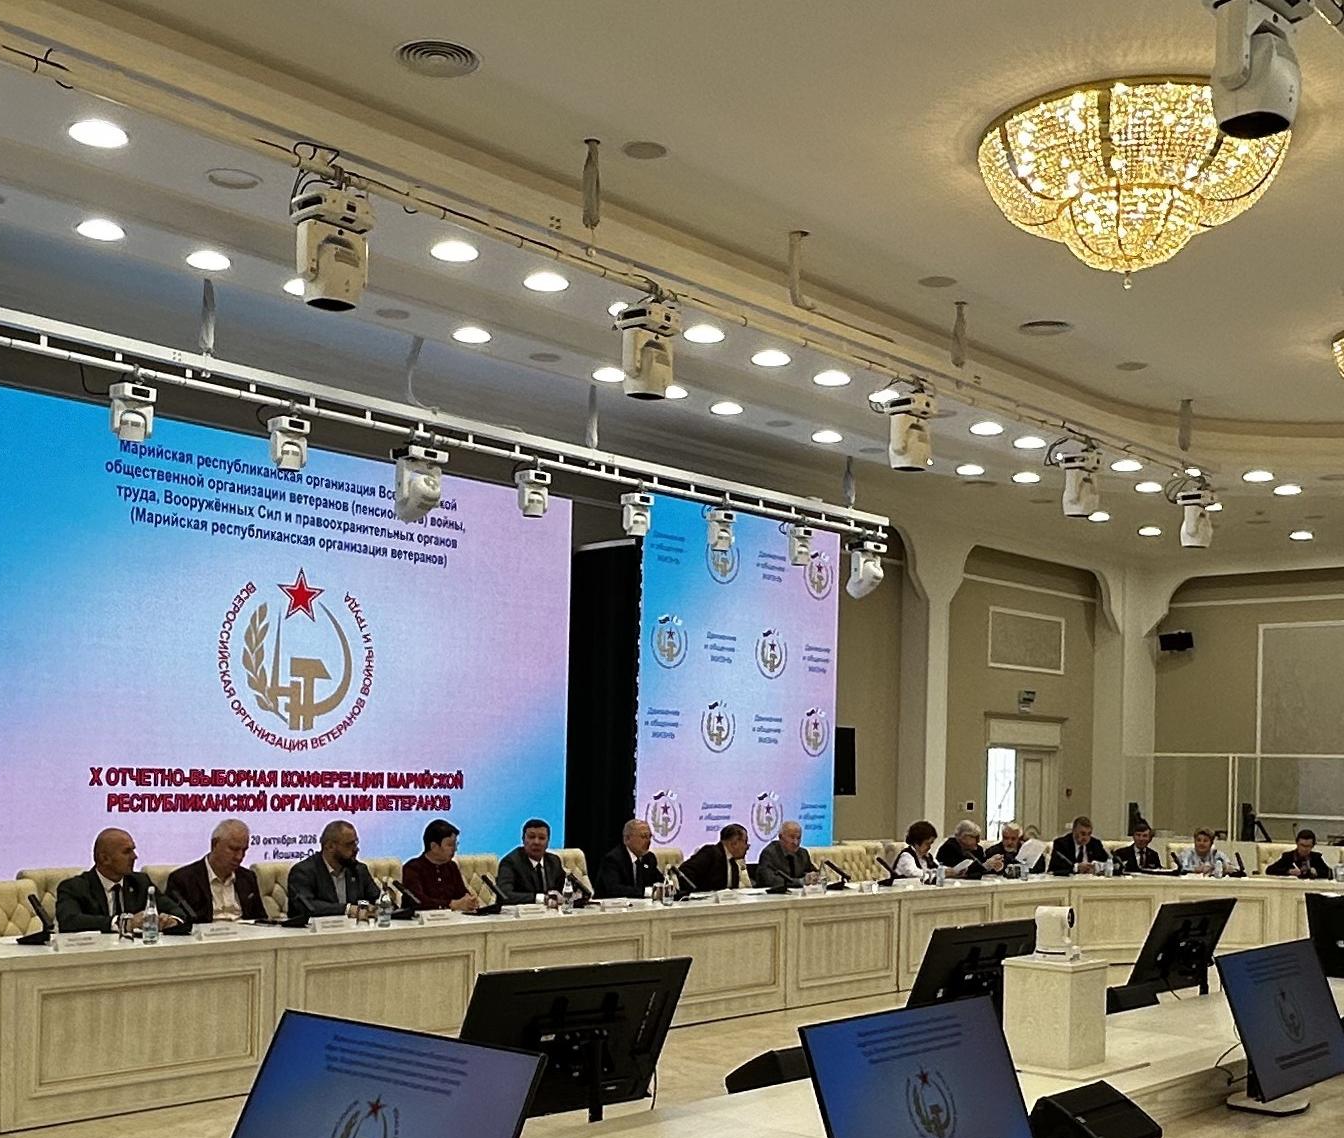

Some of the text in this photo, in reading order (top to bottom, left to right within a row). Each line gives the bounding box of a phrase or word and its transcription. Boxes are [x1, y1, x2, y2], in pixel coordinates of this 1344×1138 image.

[105, 458, 205, 488] общественной
[207, 476, 287, 501] организации
[289, 492, 349, 511] ветеранов
[430, 514, 466, 534] войны,
[119, 440, 376, 497] Марийская республиканская организация
[116, 484, 458, 550] труда, Вооружённых Сил и правоохранительных органов
[130, 506, 448, 568] (Марийская республиканская организация ветеранов)
[218, 581, 257, 698] ВСЕРОССИЙСКАЯ
[362, 632, 373, 644] И
[231, 699, 309, 752] ОРГАНИЗАЦИЯ
[311, 697, 366, 749] ВЕТЕРАНОВ
[107, 790, 268, 812] РЕСПУБЛИКАНСКОЙ
[270, 793, 374, 814] ОРГАНИЗАЦИИ
